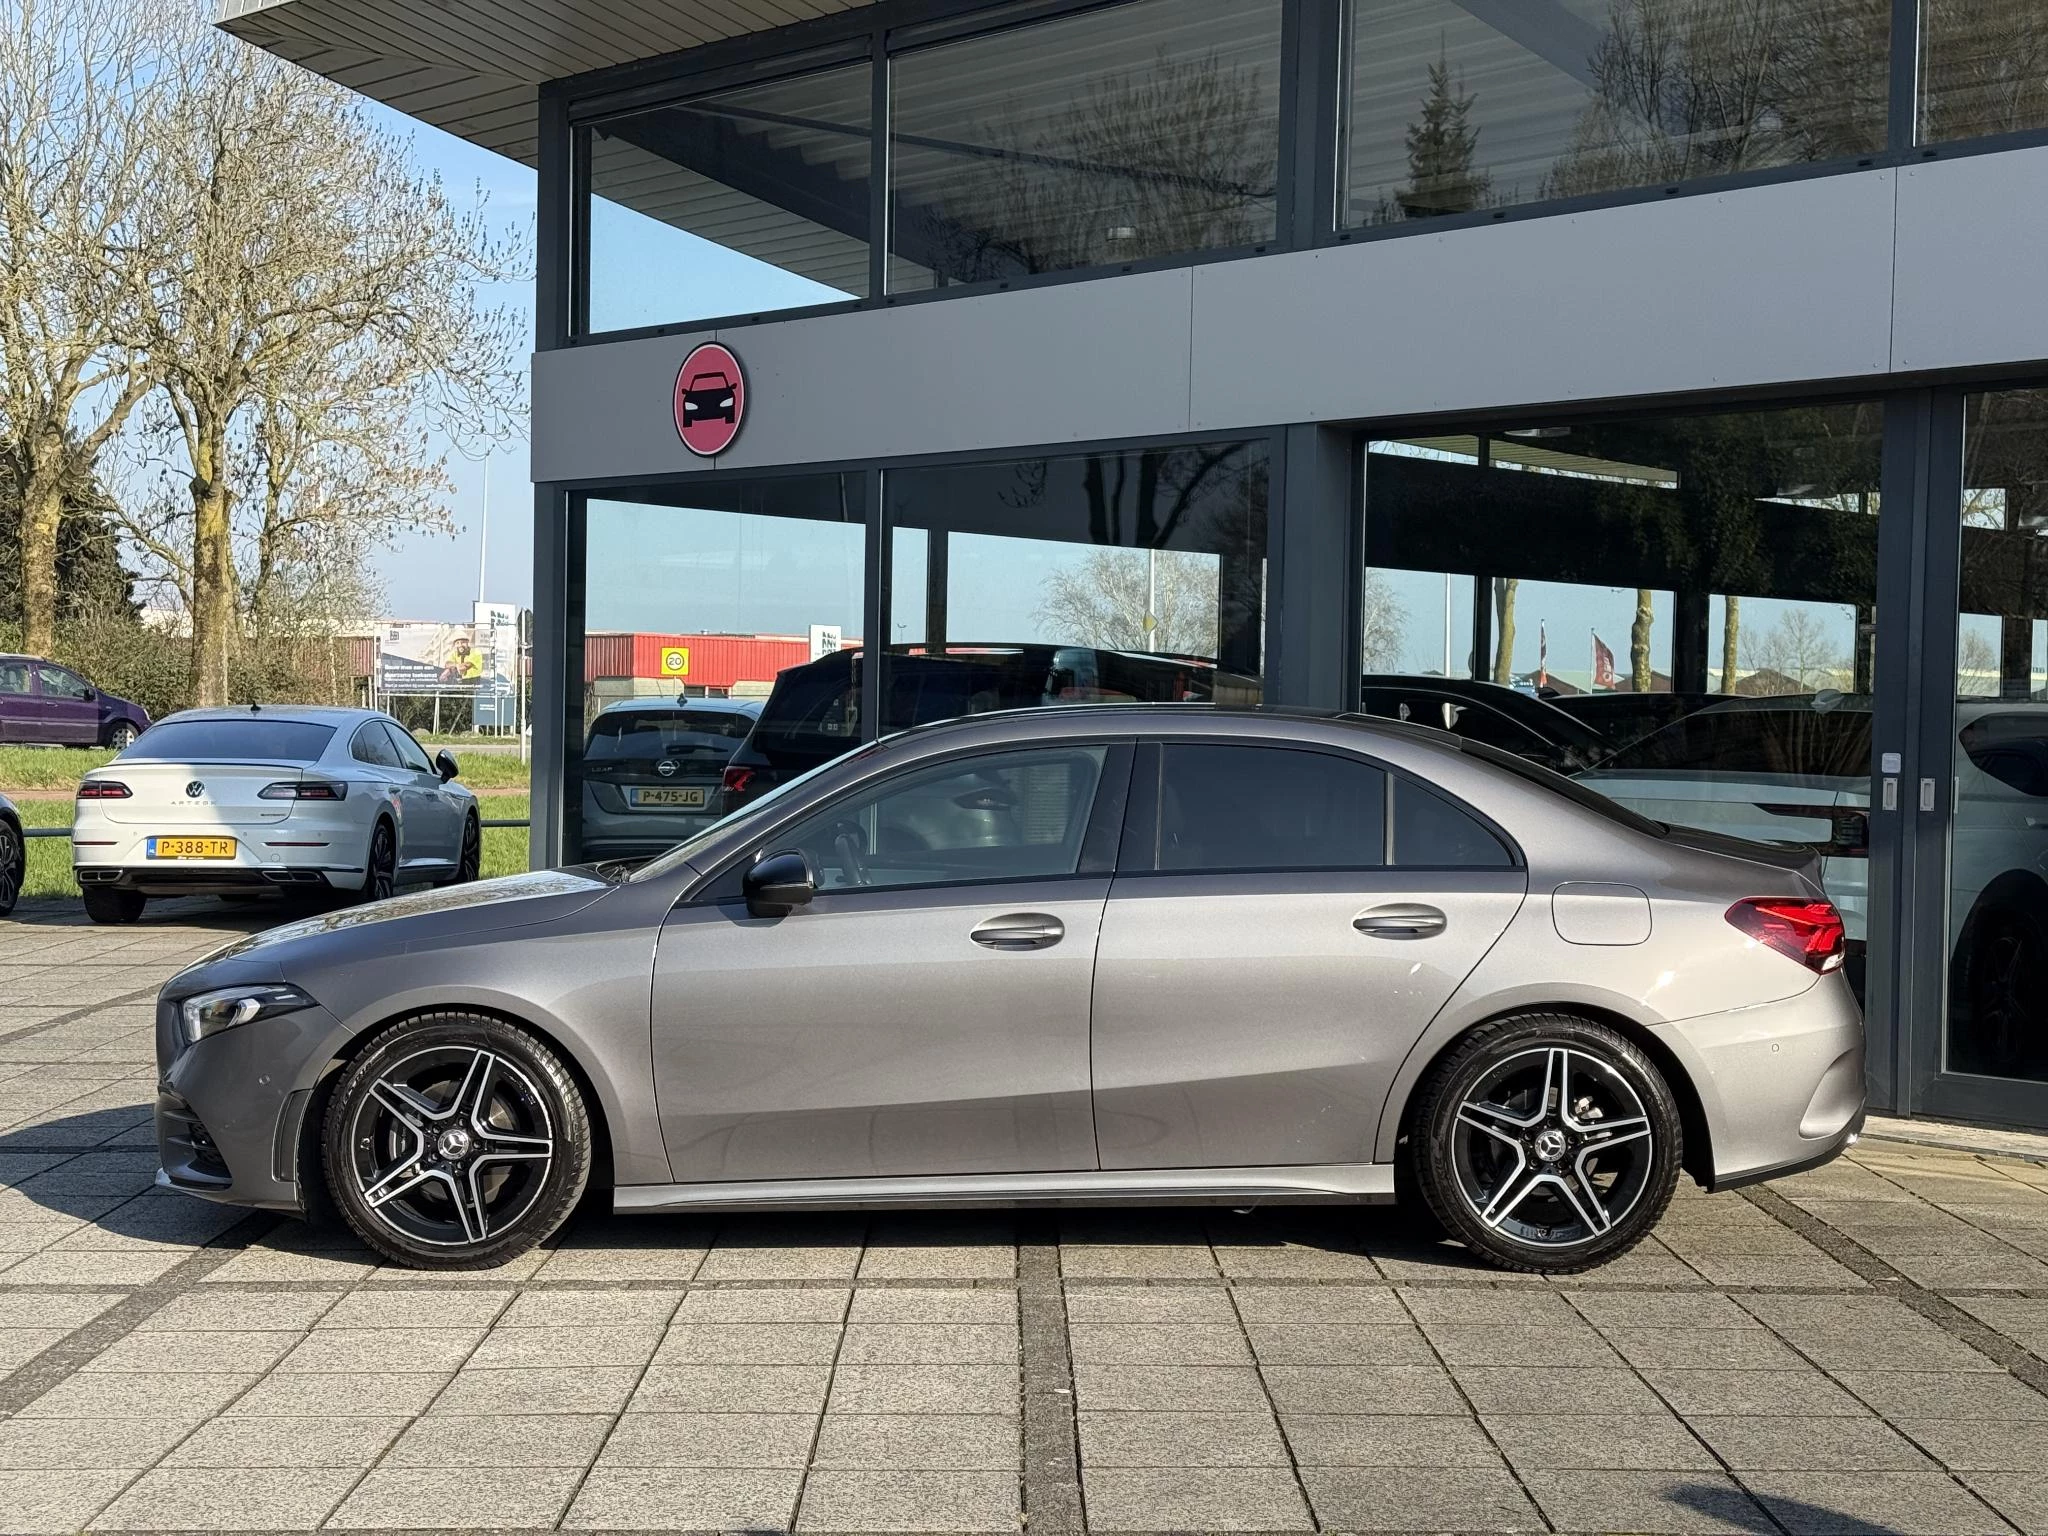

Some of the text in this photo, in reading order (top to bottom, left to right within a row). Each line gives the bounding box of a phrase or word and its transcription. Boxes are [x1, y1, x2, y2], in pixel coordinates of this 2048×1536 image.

[668, 657, 682, 666] 20
[642, 791, 699, 802] P-475-JG
[161, 841, 228, 854] P-388-TR
